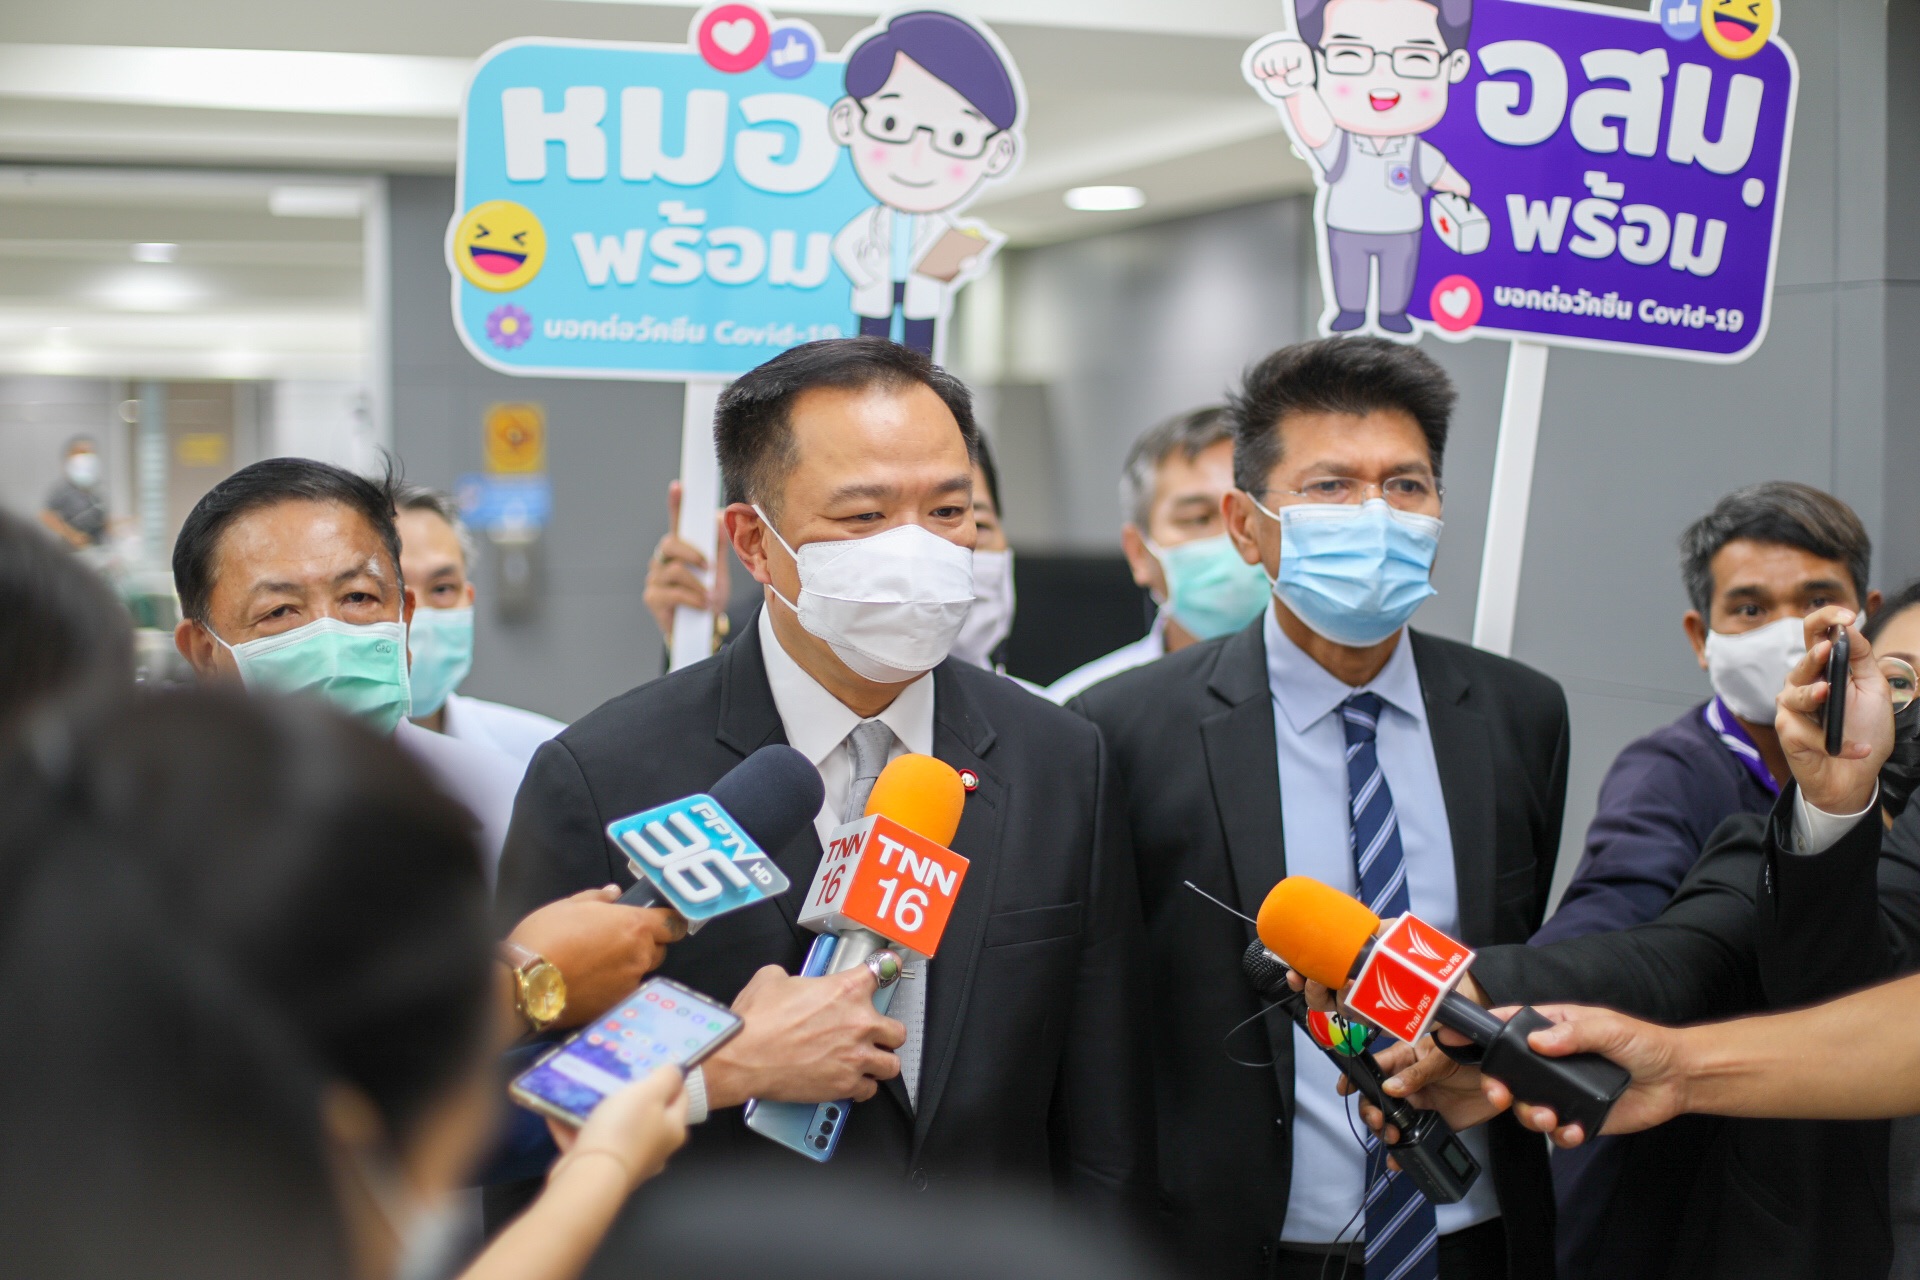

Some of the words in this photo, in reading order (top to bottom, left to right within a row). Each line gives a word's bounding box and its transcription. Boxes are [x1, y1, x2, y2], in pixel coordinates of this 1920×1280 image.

[501, 85, 840, 194] หมอ
[571, 200, 832, 288] พร้อม
[1505, 170, 1728, 277] พร้อม
[1493, 285, 1633, 320] บอกต่อวัคซีน
[1638, 298, 1744, 333] Covid-19
[623, 812, 750, 903] 36
[690, 802, 766, 861] PPTV
[826, 831, 867, 863] TNN
[750, 862, 773, 885] HD
[816, 864, 846, 906] 16
[878, 834, 957, 896] TNN
[877, 878, 929, 932] 16
[1438, 962, 1454, 977] Thai
[1449, 953, 1463, 966] PBS
[1405, 1012, 1421, 1034] Thai
[1417, 994, 1431, 1014] PBS
